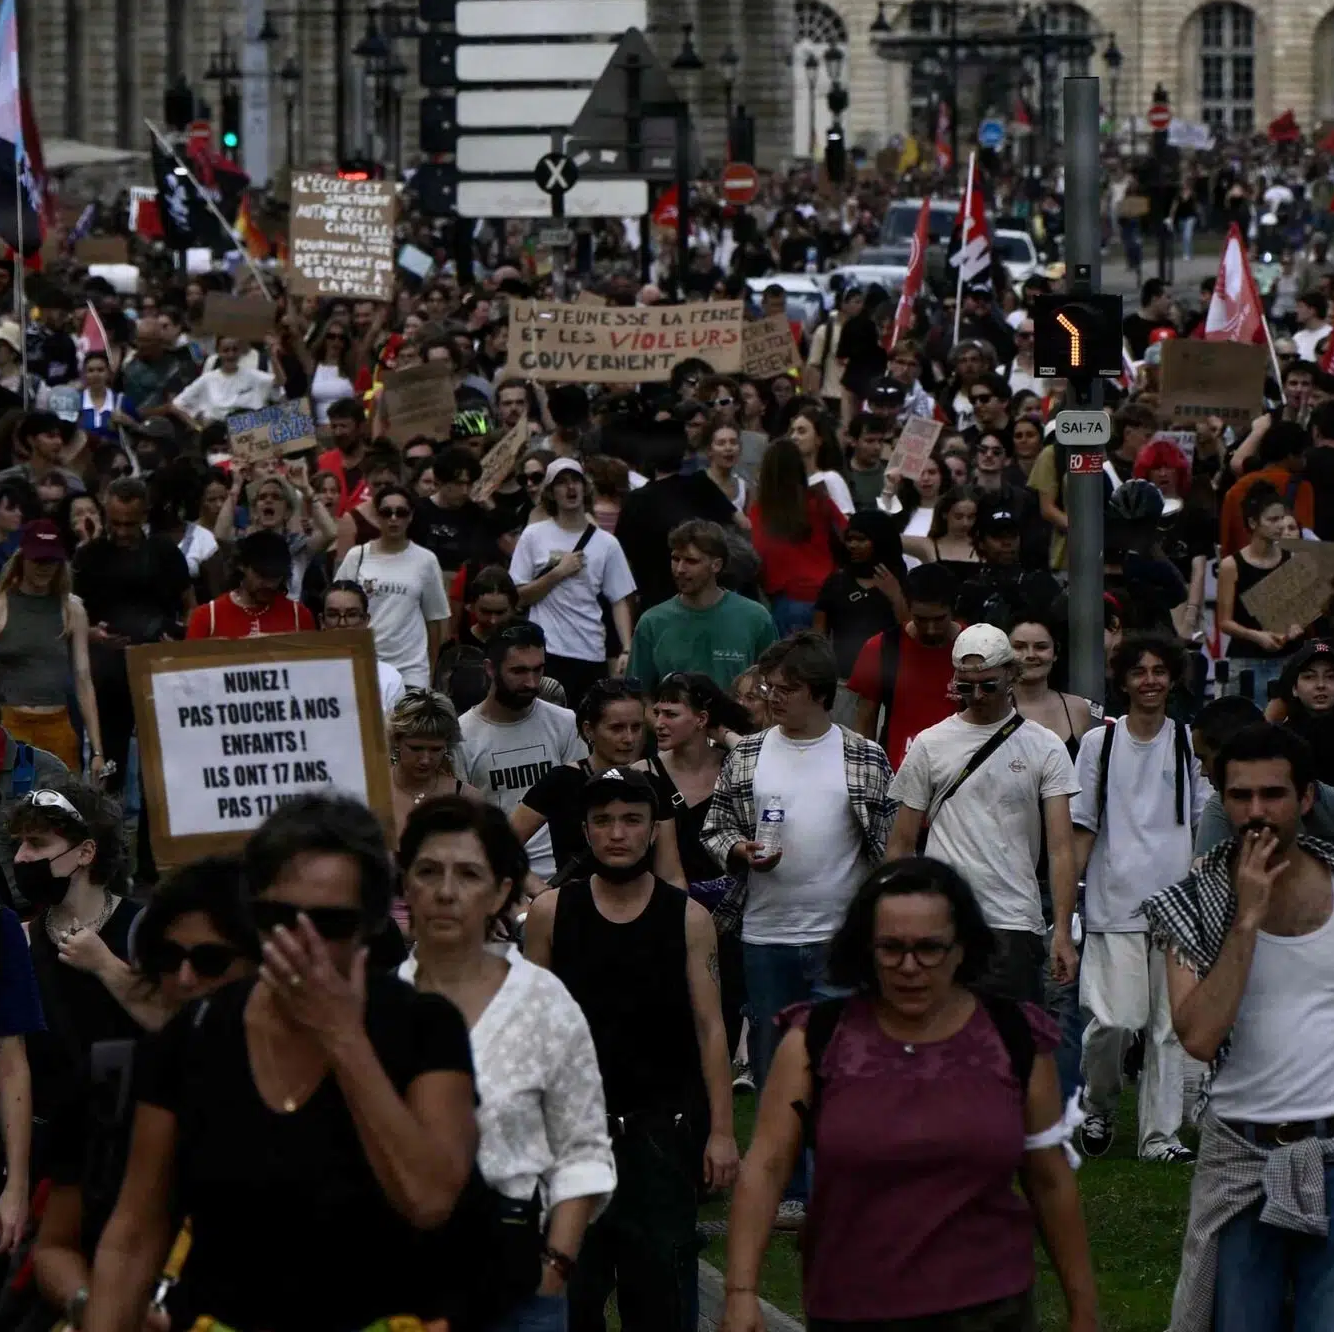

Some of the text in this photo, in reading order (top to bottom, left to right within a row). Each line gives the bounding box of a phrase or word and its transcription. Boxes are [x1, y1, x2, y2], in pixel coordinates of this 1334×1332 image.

[516, 307, 535, 323] LA
[551, 308, 647, 326] JEUNESSE
[661, 309, 683, 326] LA
[521, 328, 547, 342] ET
[559, 329, 596, 344] LES
[610, 327, 739, 351] VIOLEURS
[1061, 422, 1103, 434] SAI-7A
[224, 670, 279, 694] NUNEZ
[178, 696, 341, 728] PAS TOUCHE À NOS
[222, 730, 297, 756] ENFANTS
[203, 760, 333, 788] ILS ONT 17 ANS,
[218, 796, 252, 819] PAS
[255, 795, 272, 817] 17
